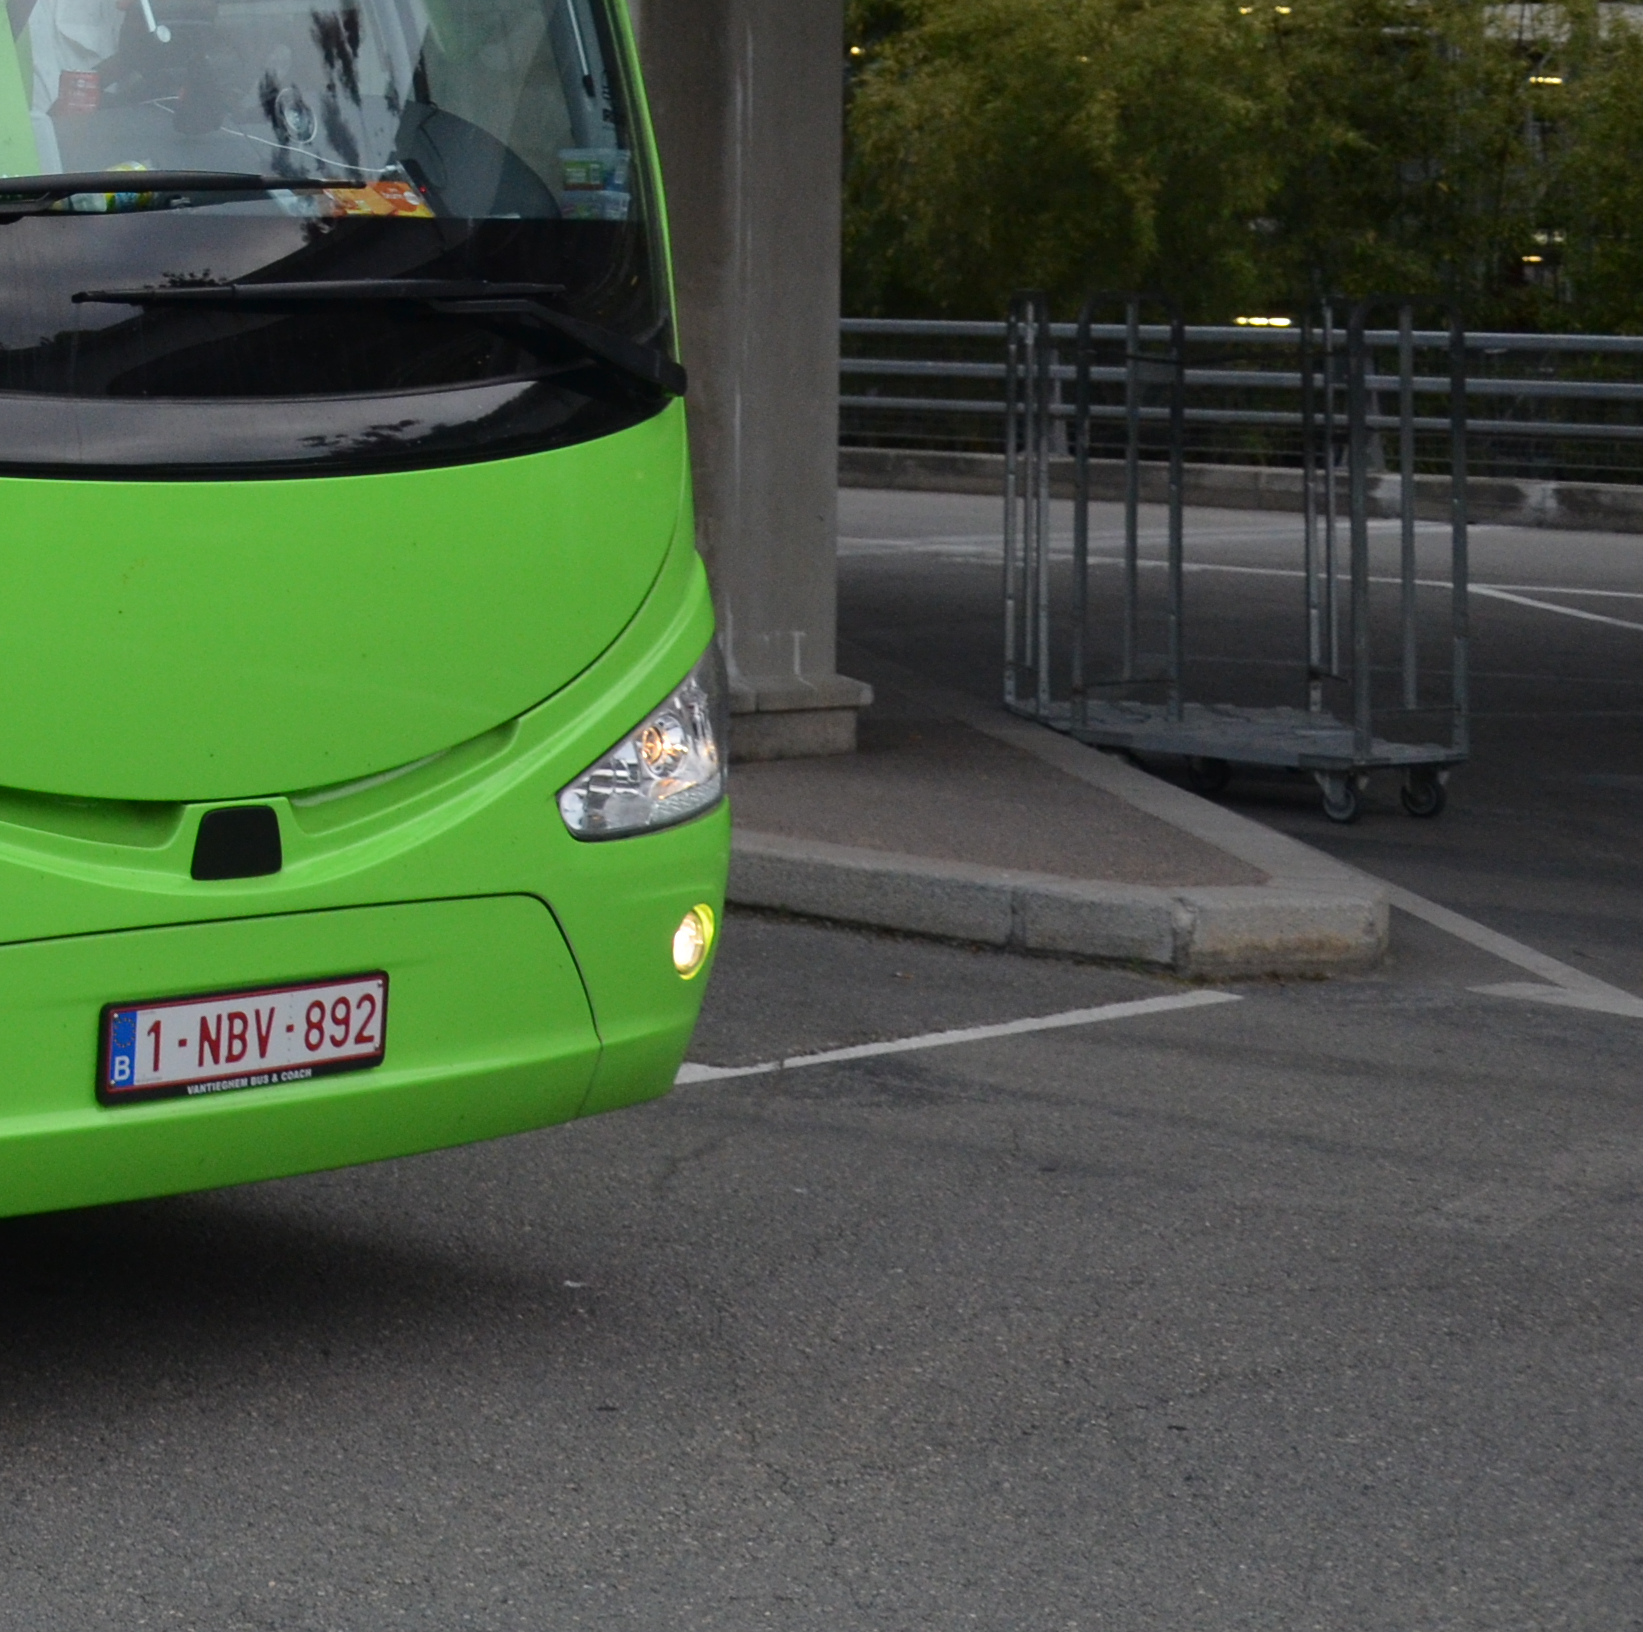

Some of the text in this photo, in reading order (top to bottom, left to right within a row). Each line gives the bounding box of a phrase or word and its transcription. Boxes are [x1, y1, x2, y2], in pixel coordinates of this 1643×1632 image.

[113, 1054, 131, 1082] B
[249, 1073, 270, 1086] BUS
[271, 1073, 279, 1083] &
[280, 1068, 313, 1082] COACH
